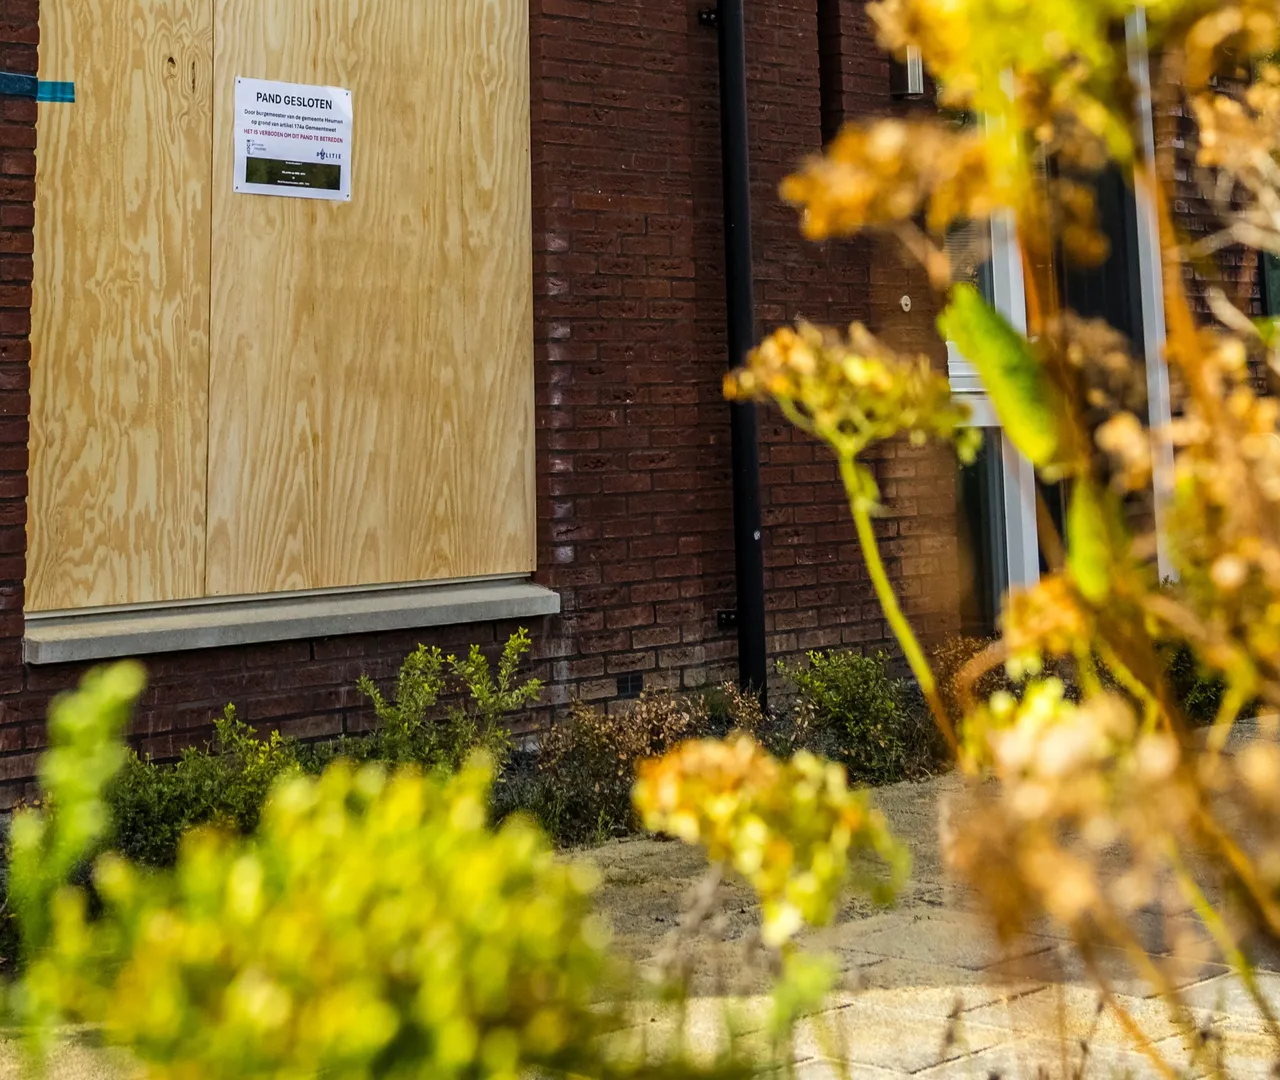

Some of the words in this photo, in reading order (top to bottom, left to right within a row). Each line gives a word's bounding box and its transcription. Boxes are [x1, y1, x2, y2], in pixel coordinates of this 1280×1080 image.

[256, 92, 282, 104] PAND
[284, 95, 332, 110] GESLOTEN
[256, 110, 286, 118] burgemeester
[305, 124, 336, 132] Gemeentewet
[320, 135, 343, 143] BETREDEN
[317, 151, 341, 160] POLITIE
